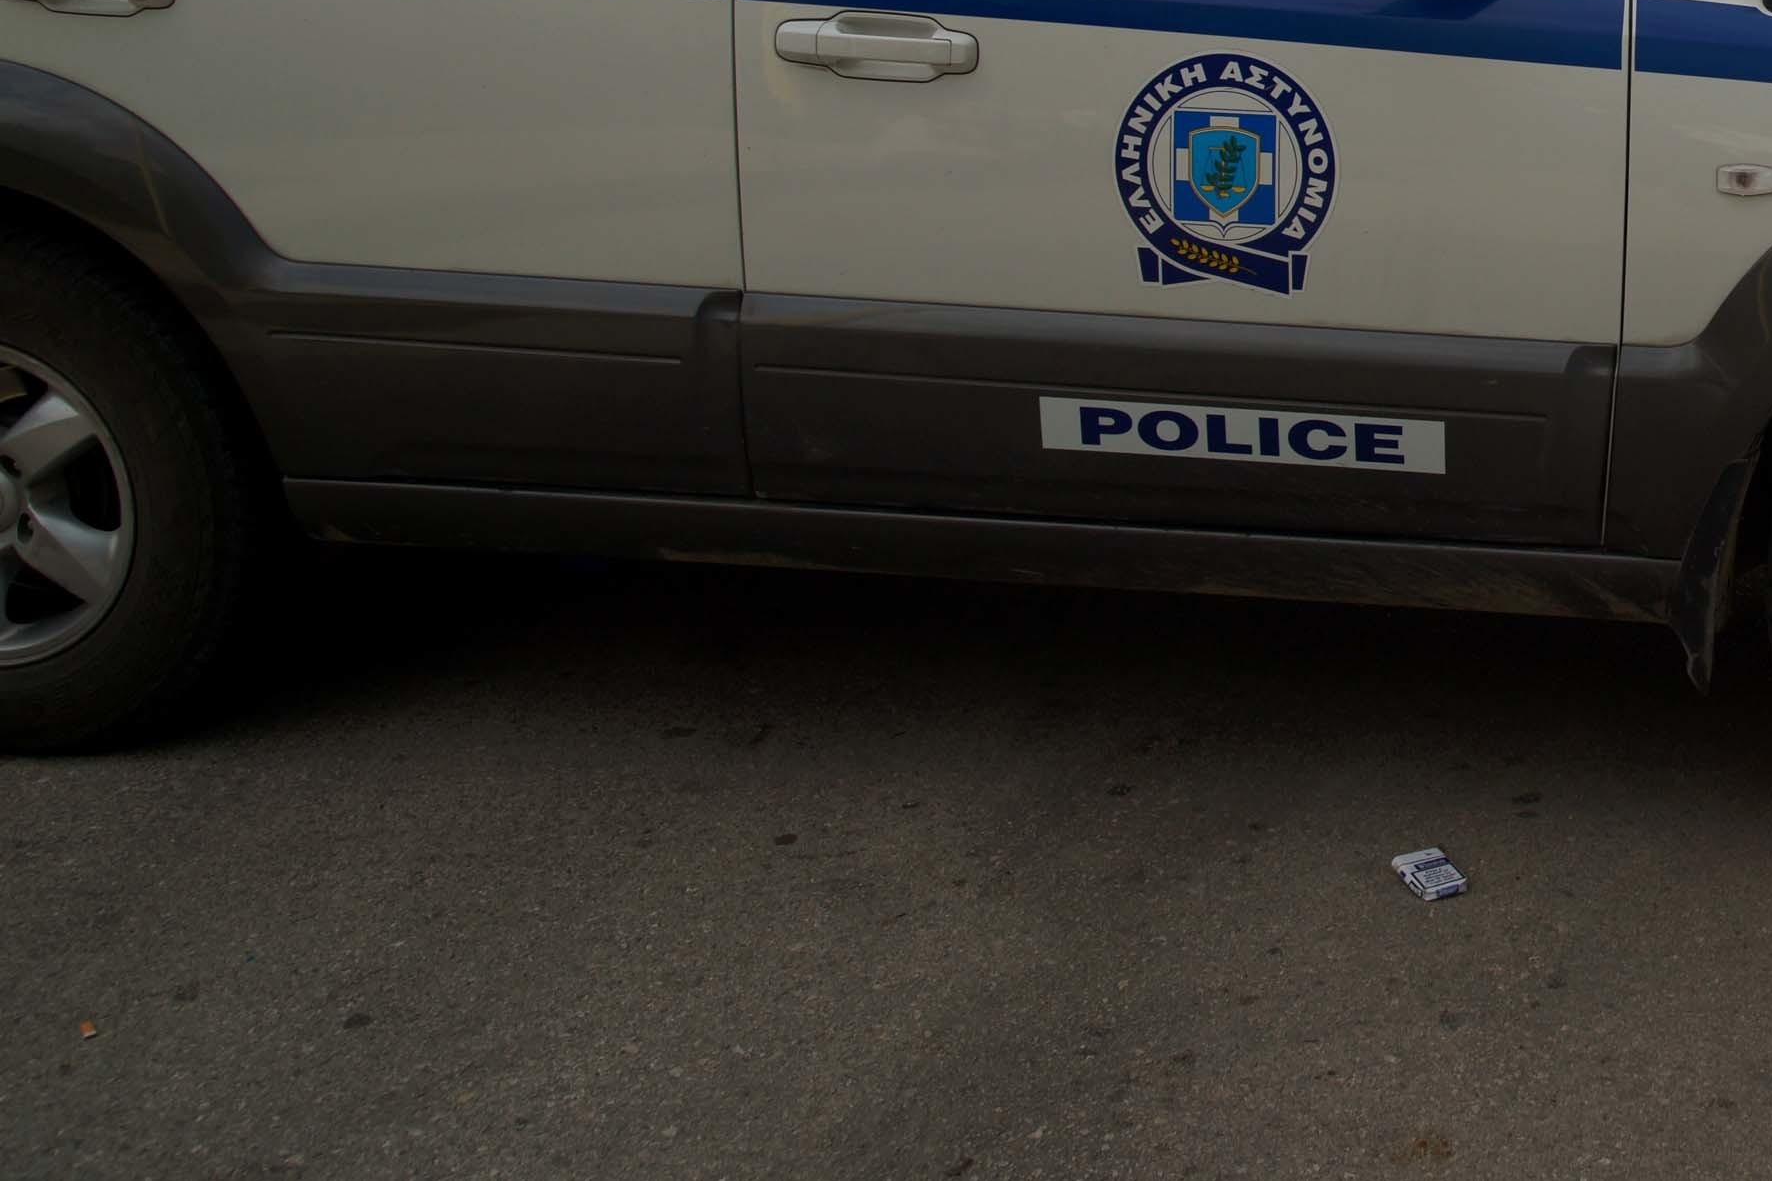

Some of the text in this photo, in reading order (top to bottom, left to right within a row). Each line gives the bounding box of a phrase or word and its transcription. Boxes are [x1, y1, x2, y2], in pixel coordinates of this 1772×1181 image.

[1120, 60, 1329, 241] ΕΛΛΗΝΙΚΗ ΑΣΤΥΝΟΜΙΑ
[1079, 406, 1405, 465] POLICE
